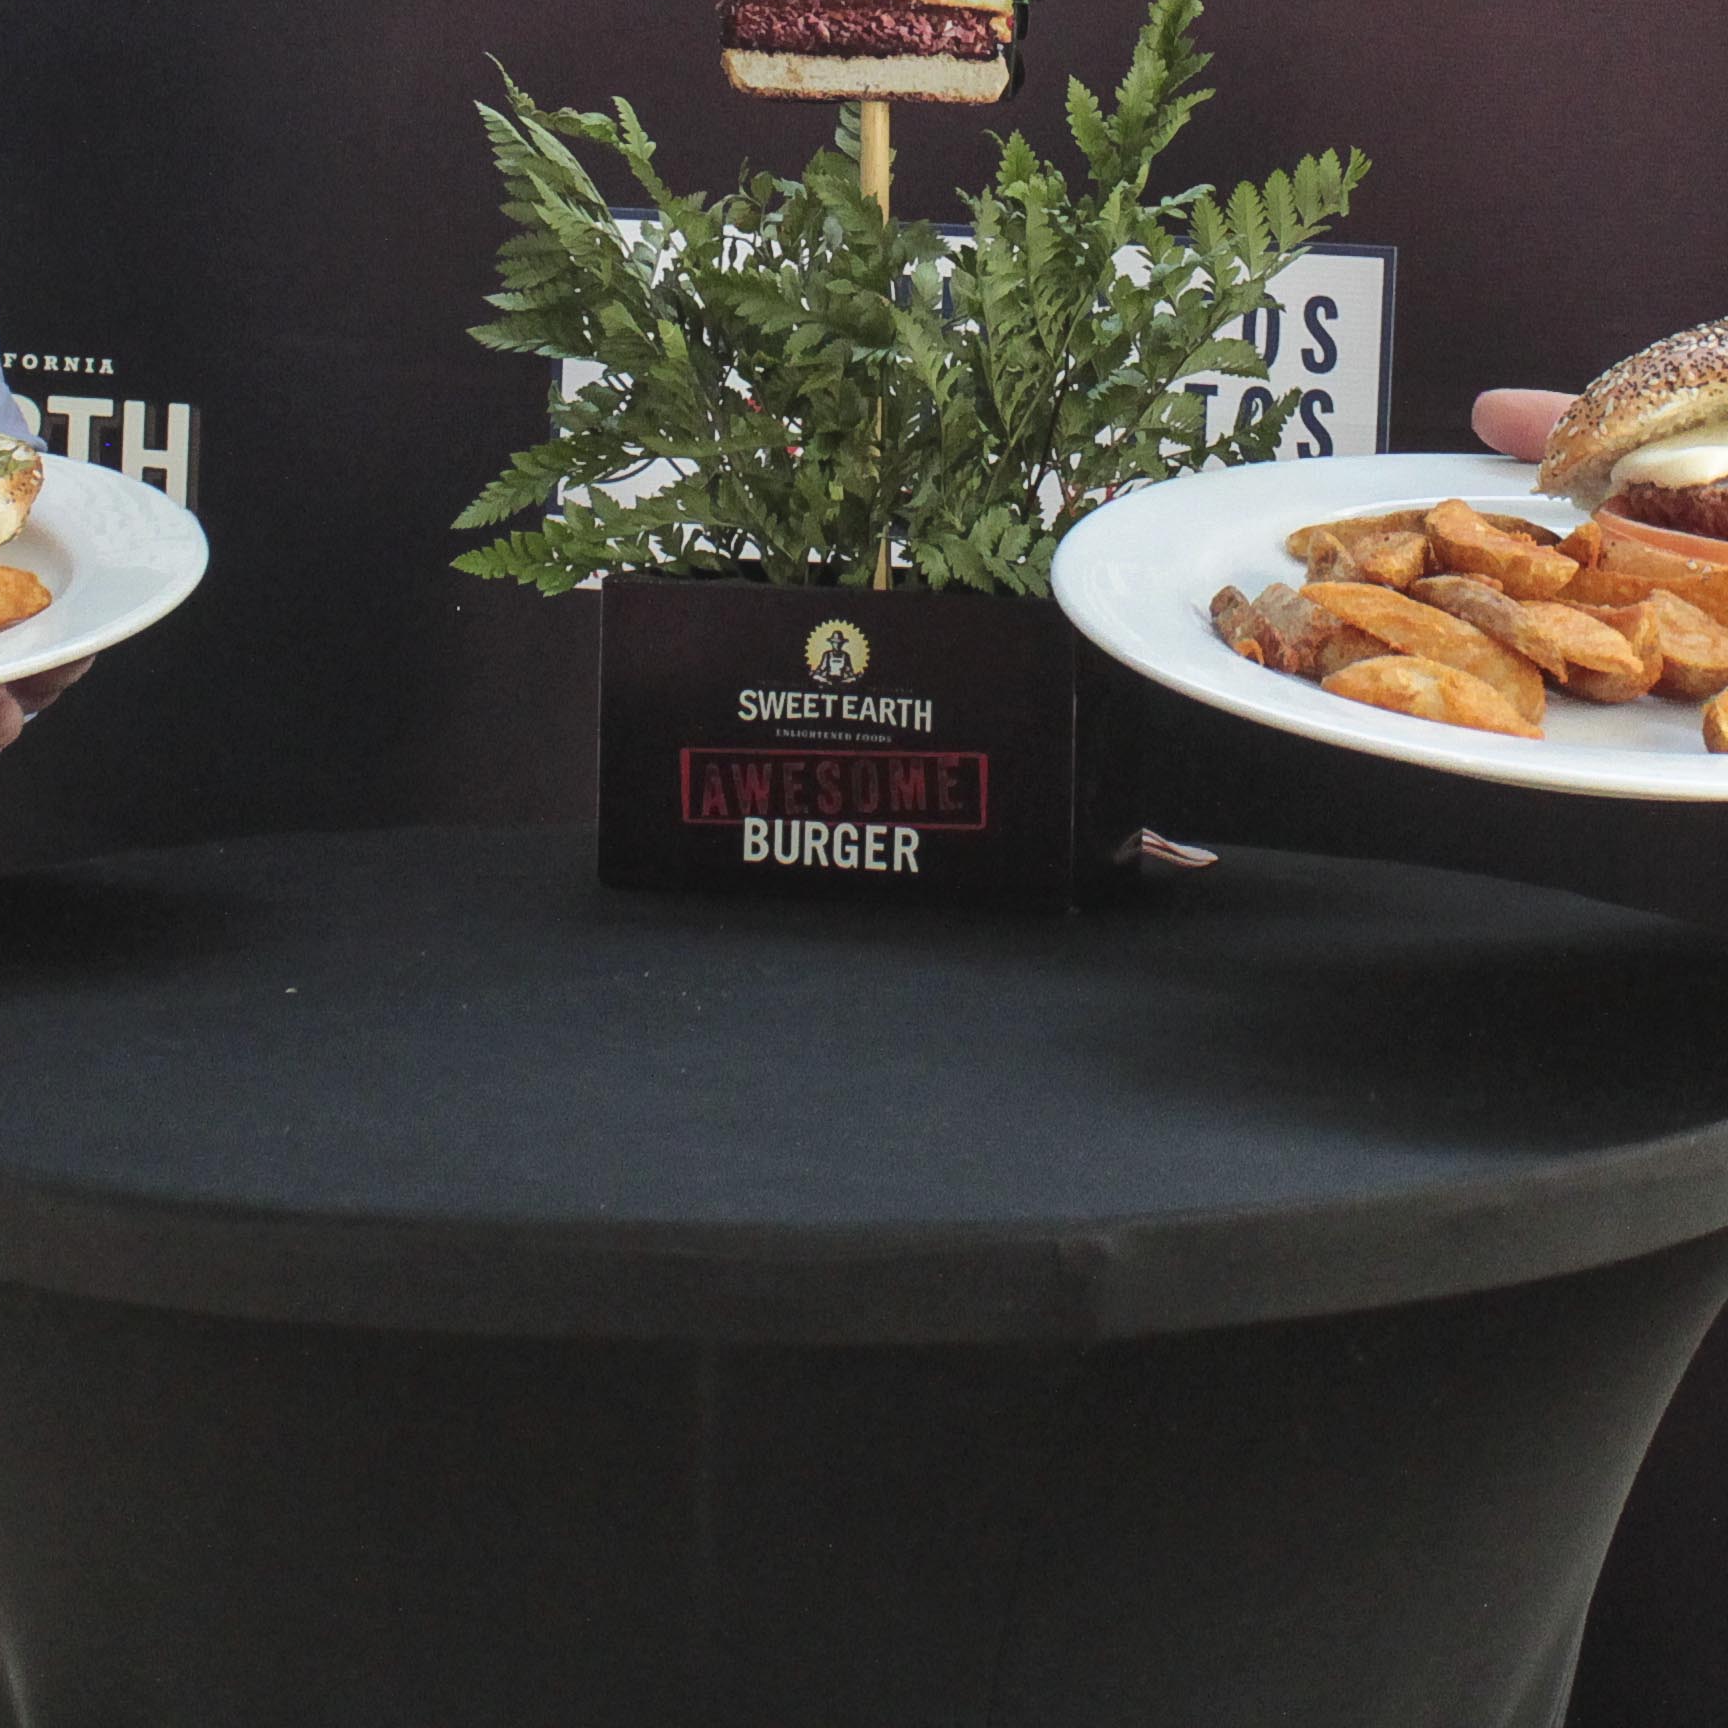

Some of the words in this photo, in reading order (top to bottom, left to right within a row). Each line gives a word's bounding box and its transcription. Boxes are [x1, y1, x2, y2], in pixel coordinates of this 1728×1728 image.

[738, 690, 838, 721] SWEET
[842, 696, 932, 732] EARTH
[702, 755, 963, 816] AWESOME
[743, 816, 920, 873] BURGER
